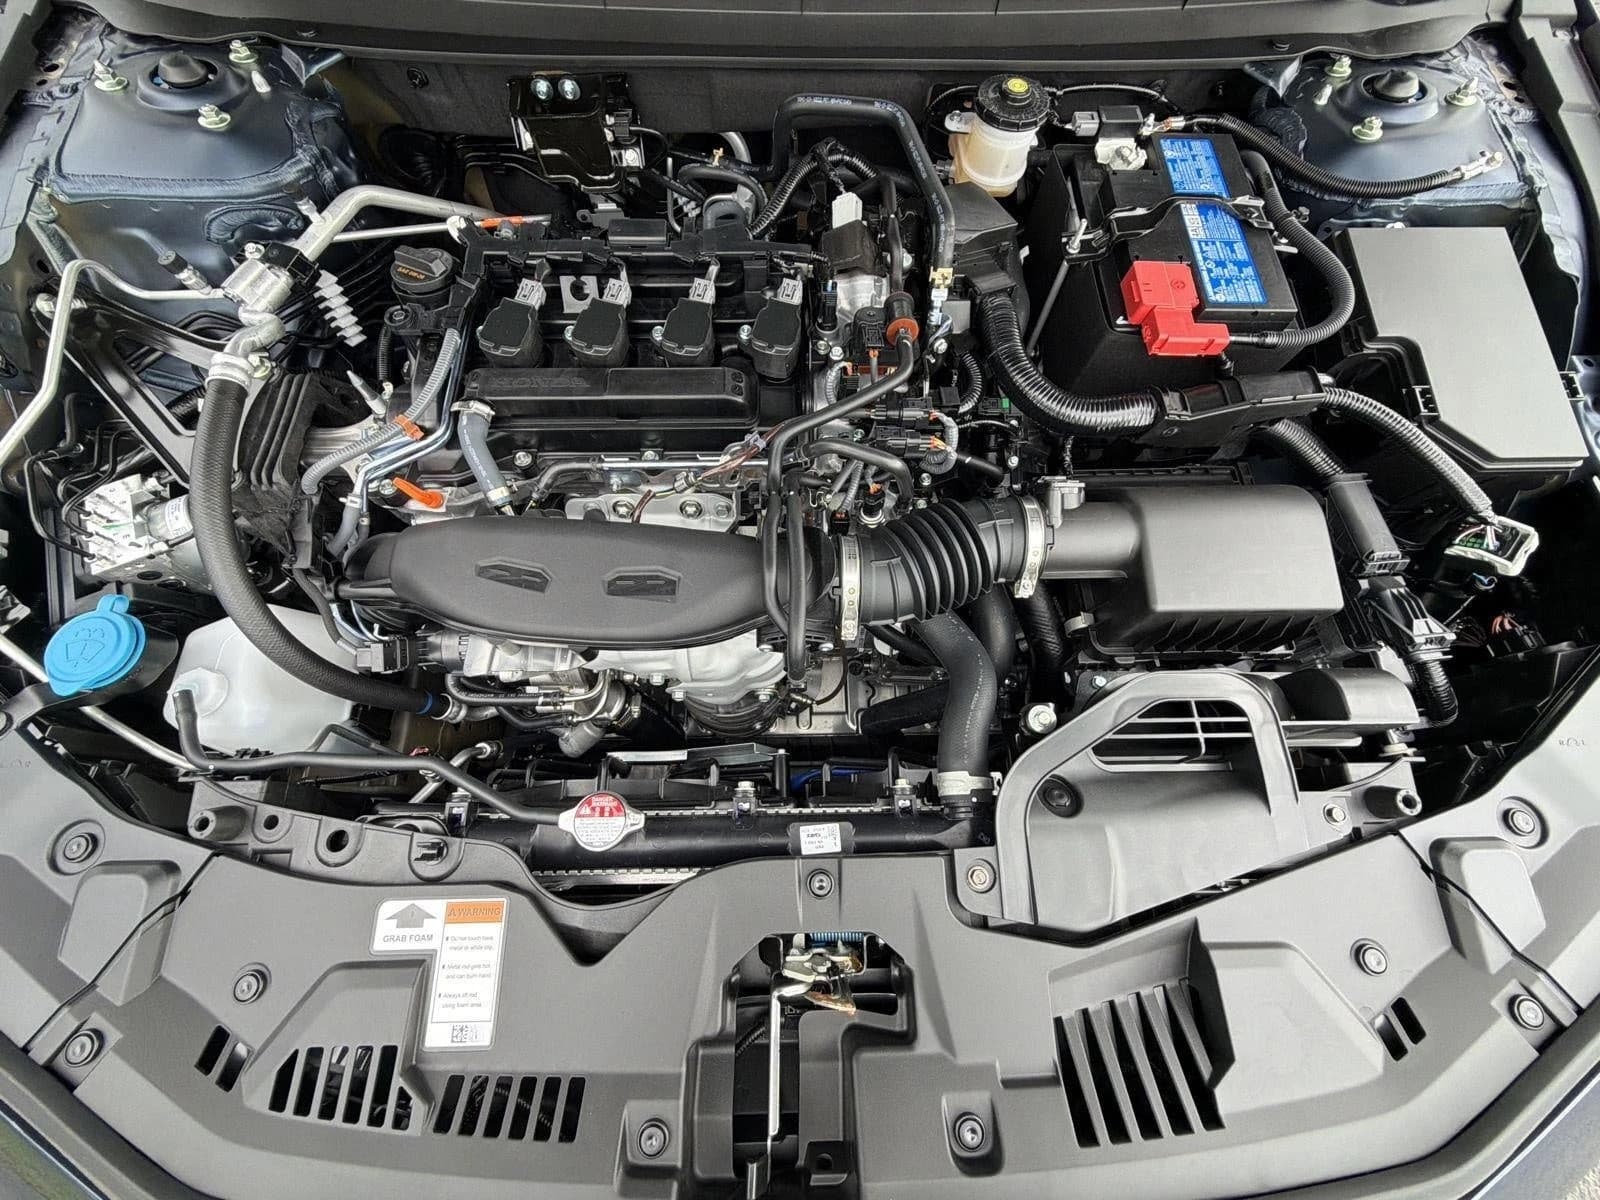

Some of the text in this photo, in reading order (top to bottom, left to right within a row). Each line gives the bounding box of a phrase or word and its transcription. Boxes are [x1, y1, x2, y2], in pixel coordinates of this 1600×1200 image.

[458, 907, 500, 917] WARNING
[383, 934, 434, 943] GRAB FOAM
